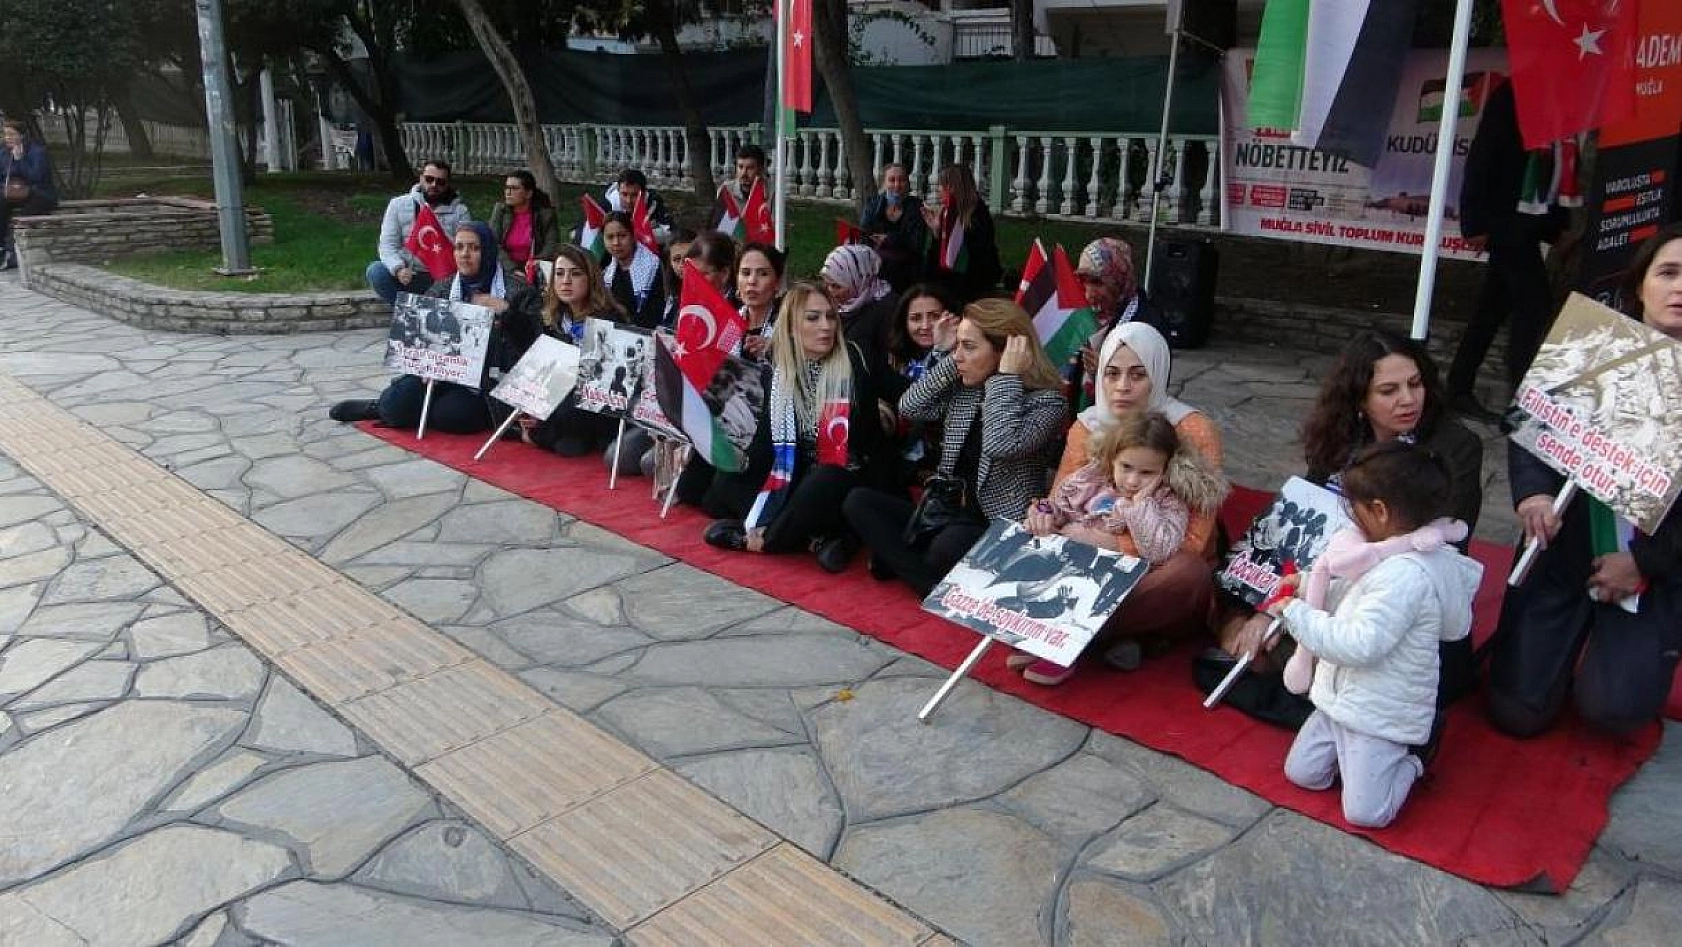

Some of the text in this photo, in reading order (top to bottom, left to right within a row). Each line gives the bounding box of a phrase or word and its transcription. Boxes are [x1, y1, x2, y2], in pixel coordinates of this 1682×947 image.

[1387, 131, 1439, 154] KUDÜ
[1260, 216, 1302, 231] MUĞLA
[1304, 220, 1335, 237] SİVİL
[1338, 224, 1394, 244] TOPLUM
[1537, 432, 1582, 471] sende
[1582, 427, 1635, 473] destek
[1635, 462, 1670, 497] için
